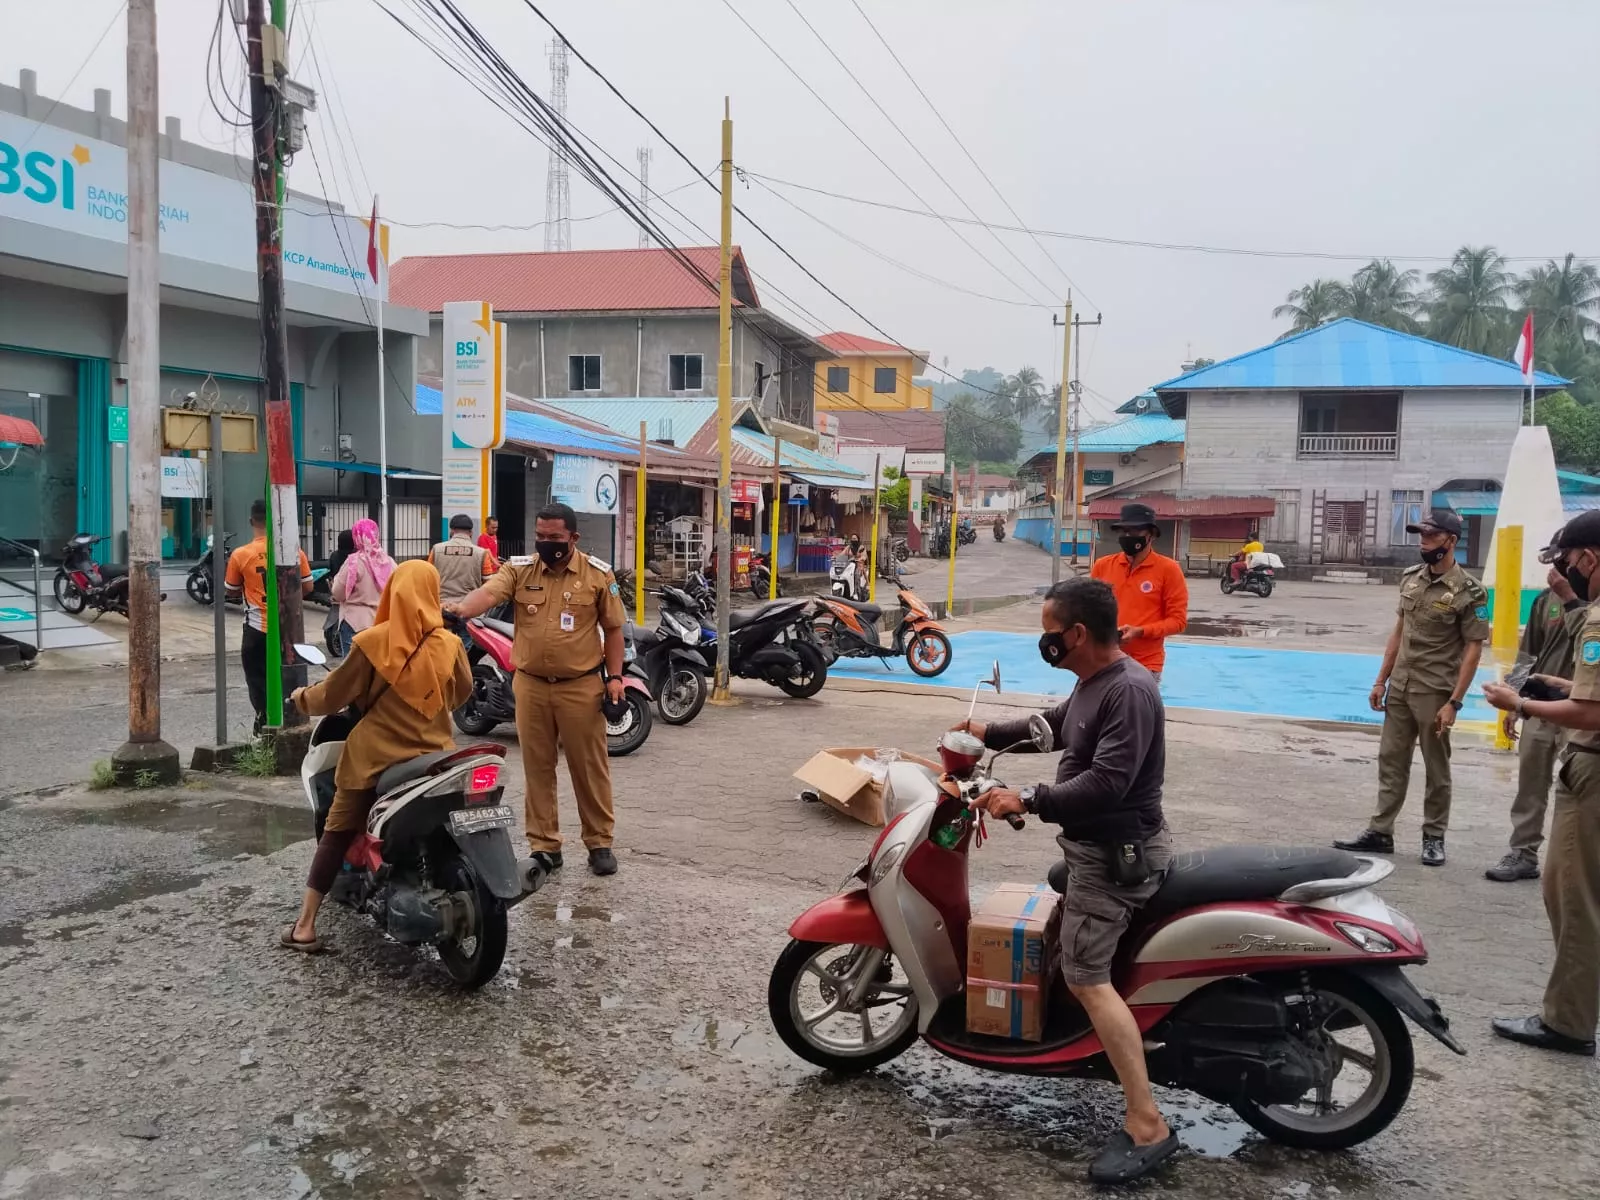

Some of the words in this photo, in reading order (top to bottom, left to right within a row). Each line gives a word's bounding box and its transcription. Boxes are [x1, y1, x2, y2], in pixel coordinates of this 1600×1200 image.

[0, 141, 74, 210] BSI
[88, 204, 166, 232] INDOA
[159, 204, 190, 223] RIAH
[284, 249, 305, 264] KCP
[307, 256, 349, 276] Anambas
[456, 341, 478, 356] BSI
[457, 397, 477, 407] ATM
[164, 467, 179, 477] BSI
